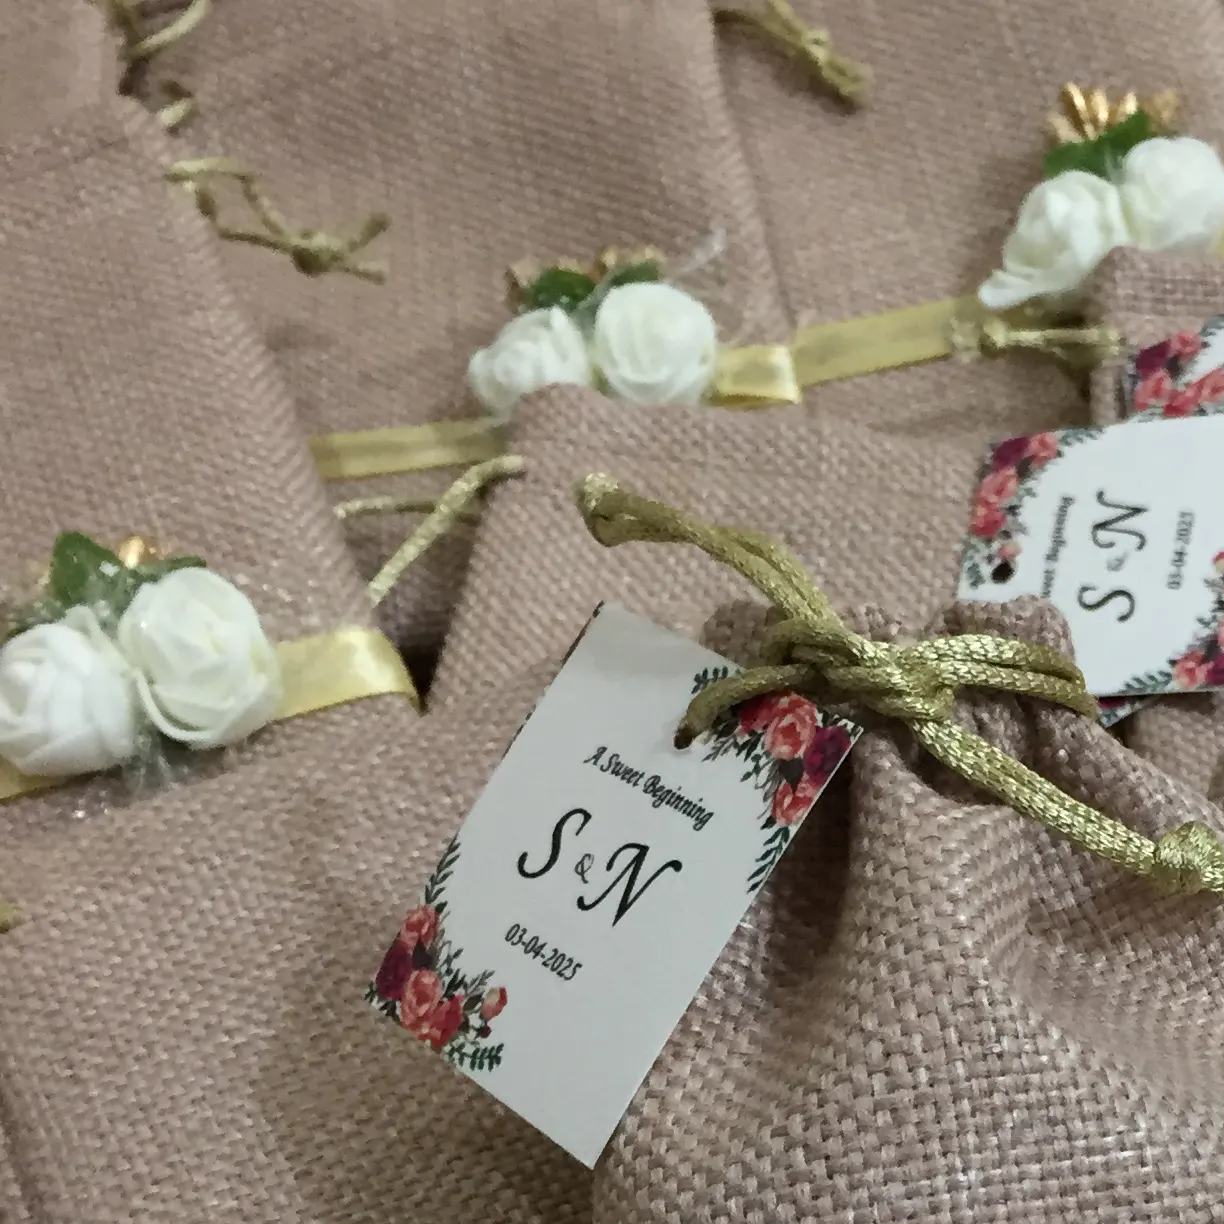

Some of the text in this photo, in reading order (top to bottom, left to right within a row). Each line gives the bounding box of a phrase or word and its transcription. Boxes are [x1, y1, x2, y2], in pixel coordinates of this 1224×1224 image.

[1045, 495, 1075, 562] Beginning
[583, 746, 714, 831] A Sweet Beginning
[504, 923, 583, 981] 03-04-2025
